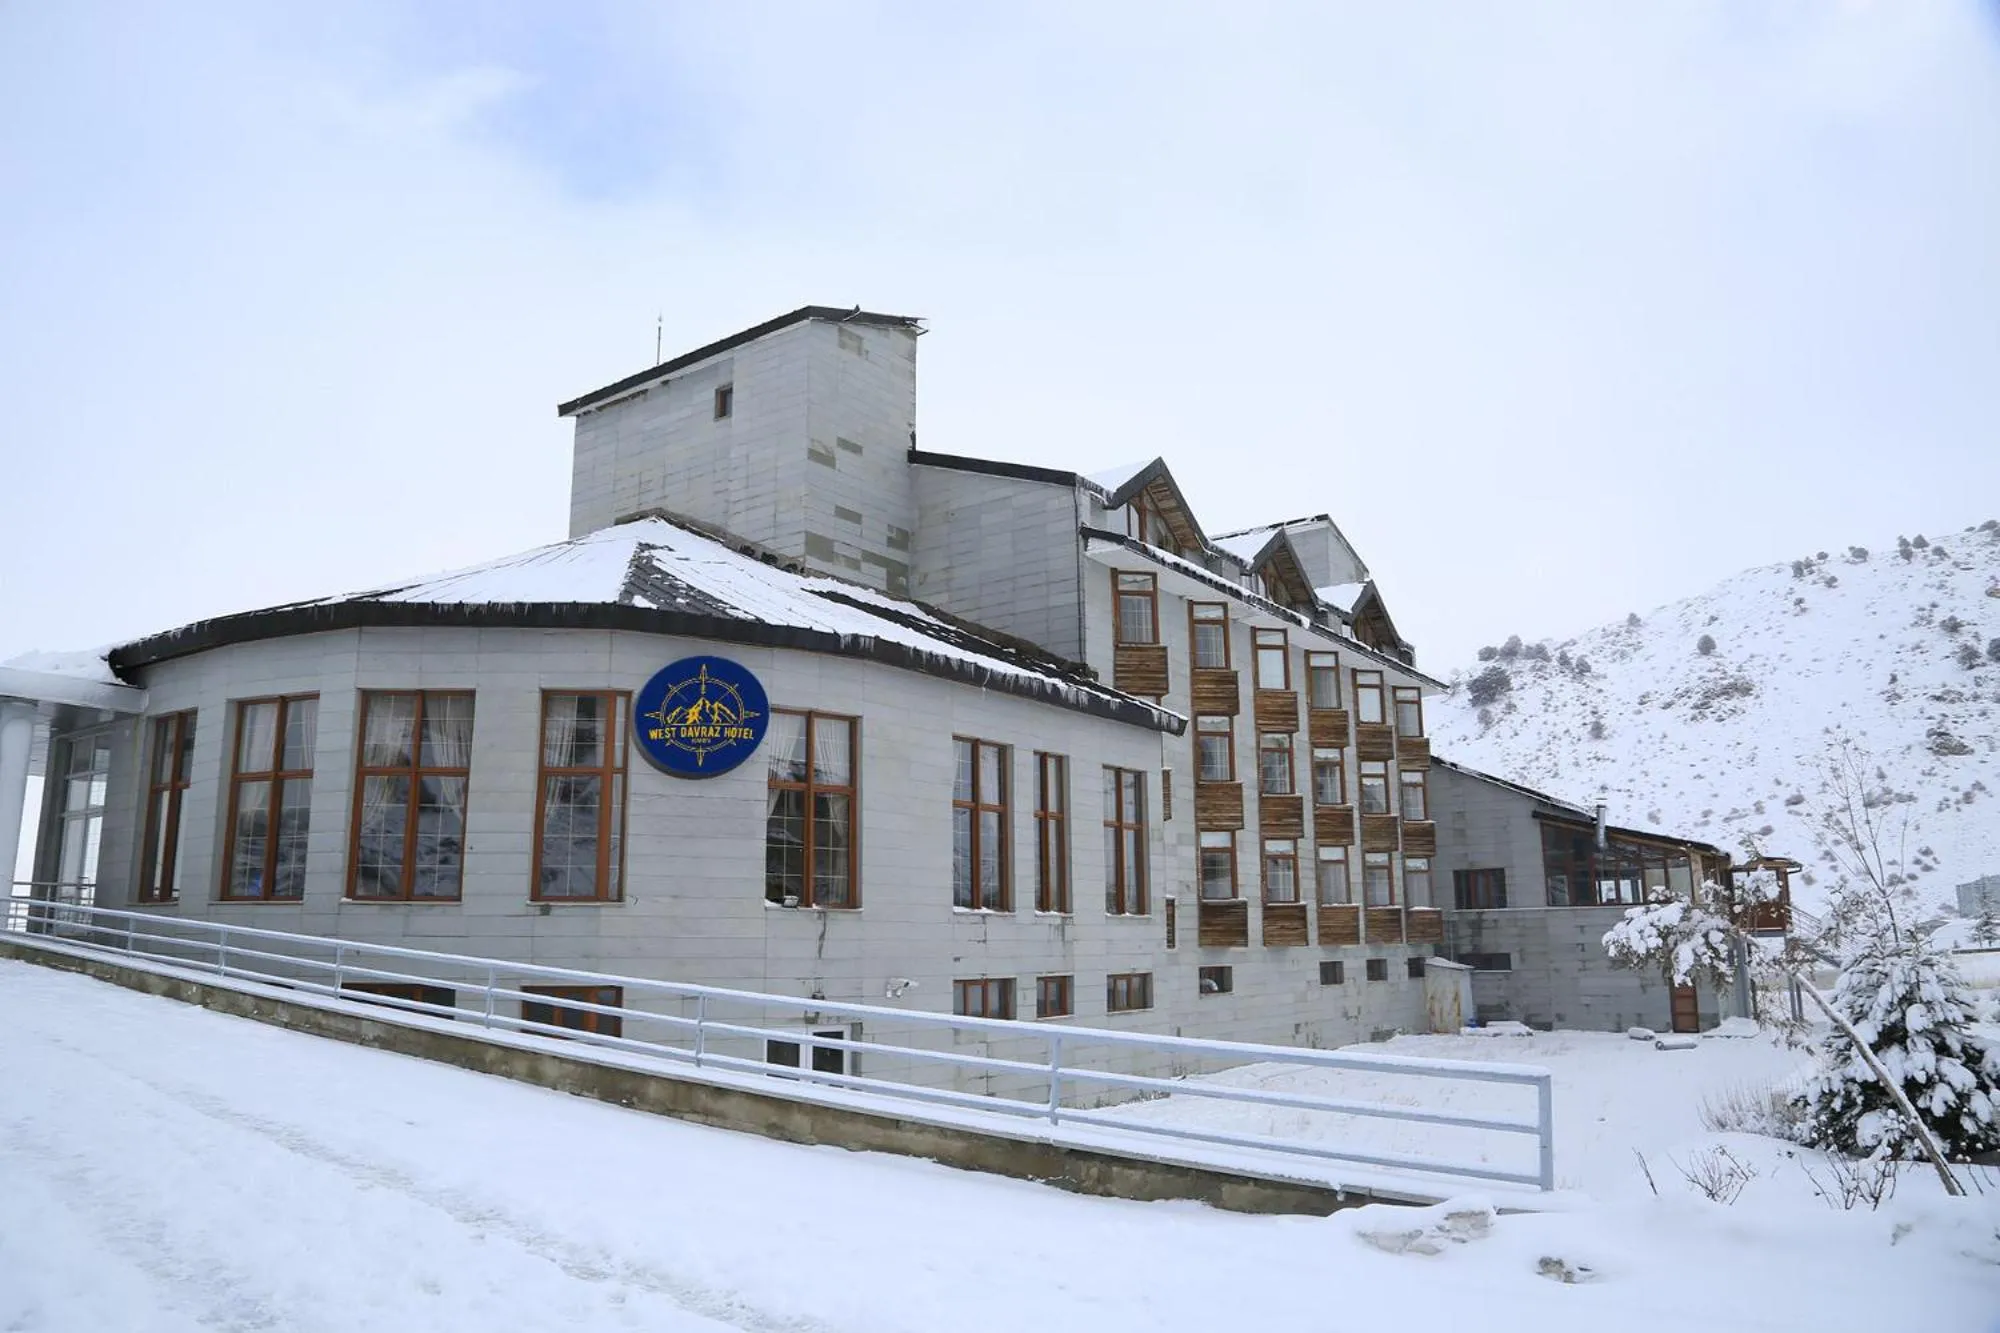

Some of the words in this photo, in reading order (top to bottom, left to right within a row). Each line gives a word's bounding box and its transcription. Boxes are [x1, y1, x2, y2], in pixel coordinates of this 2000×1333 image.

[648, 727, 676, 739] WEST
[680, 726, 720, 738] DAVRAZ
[724, 727, 754, 740] HOTEL
